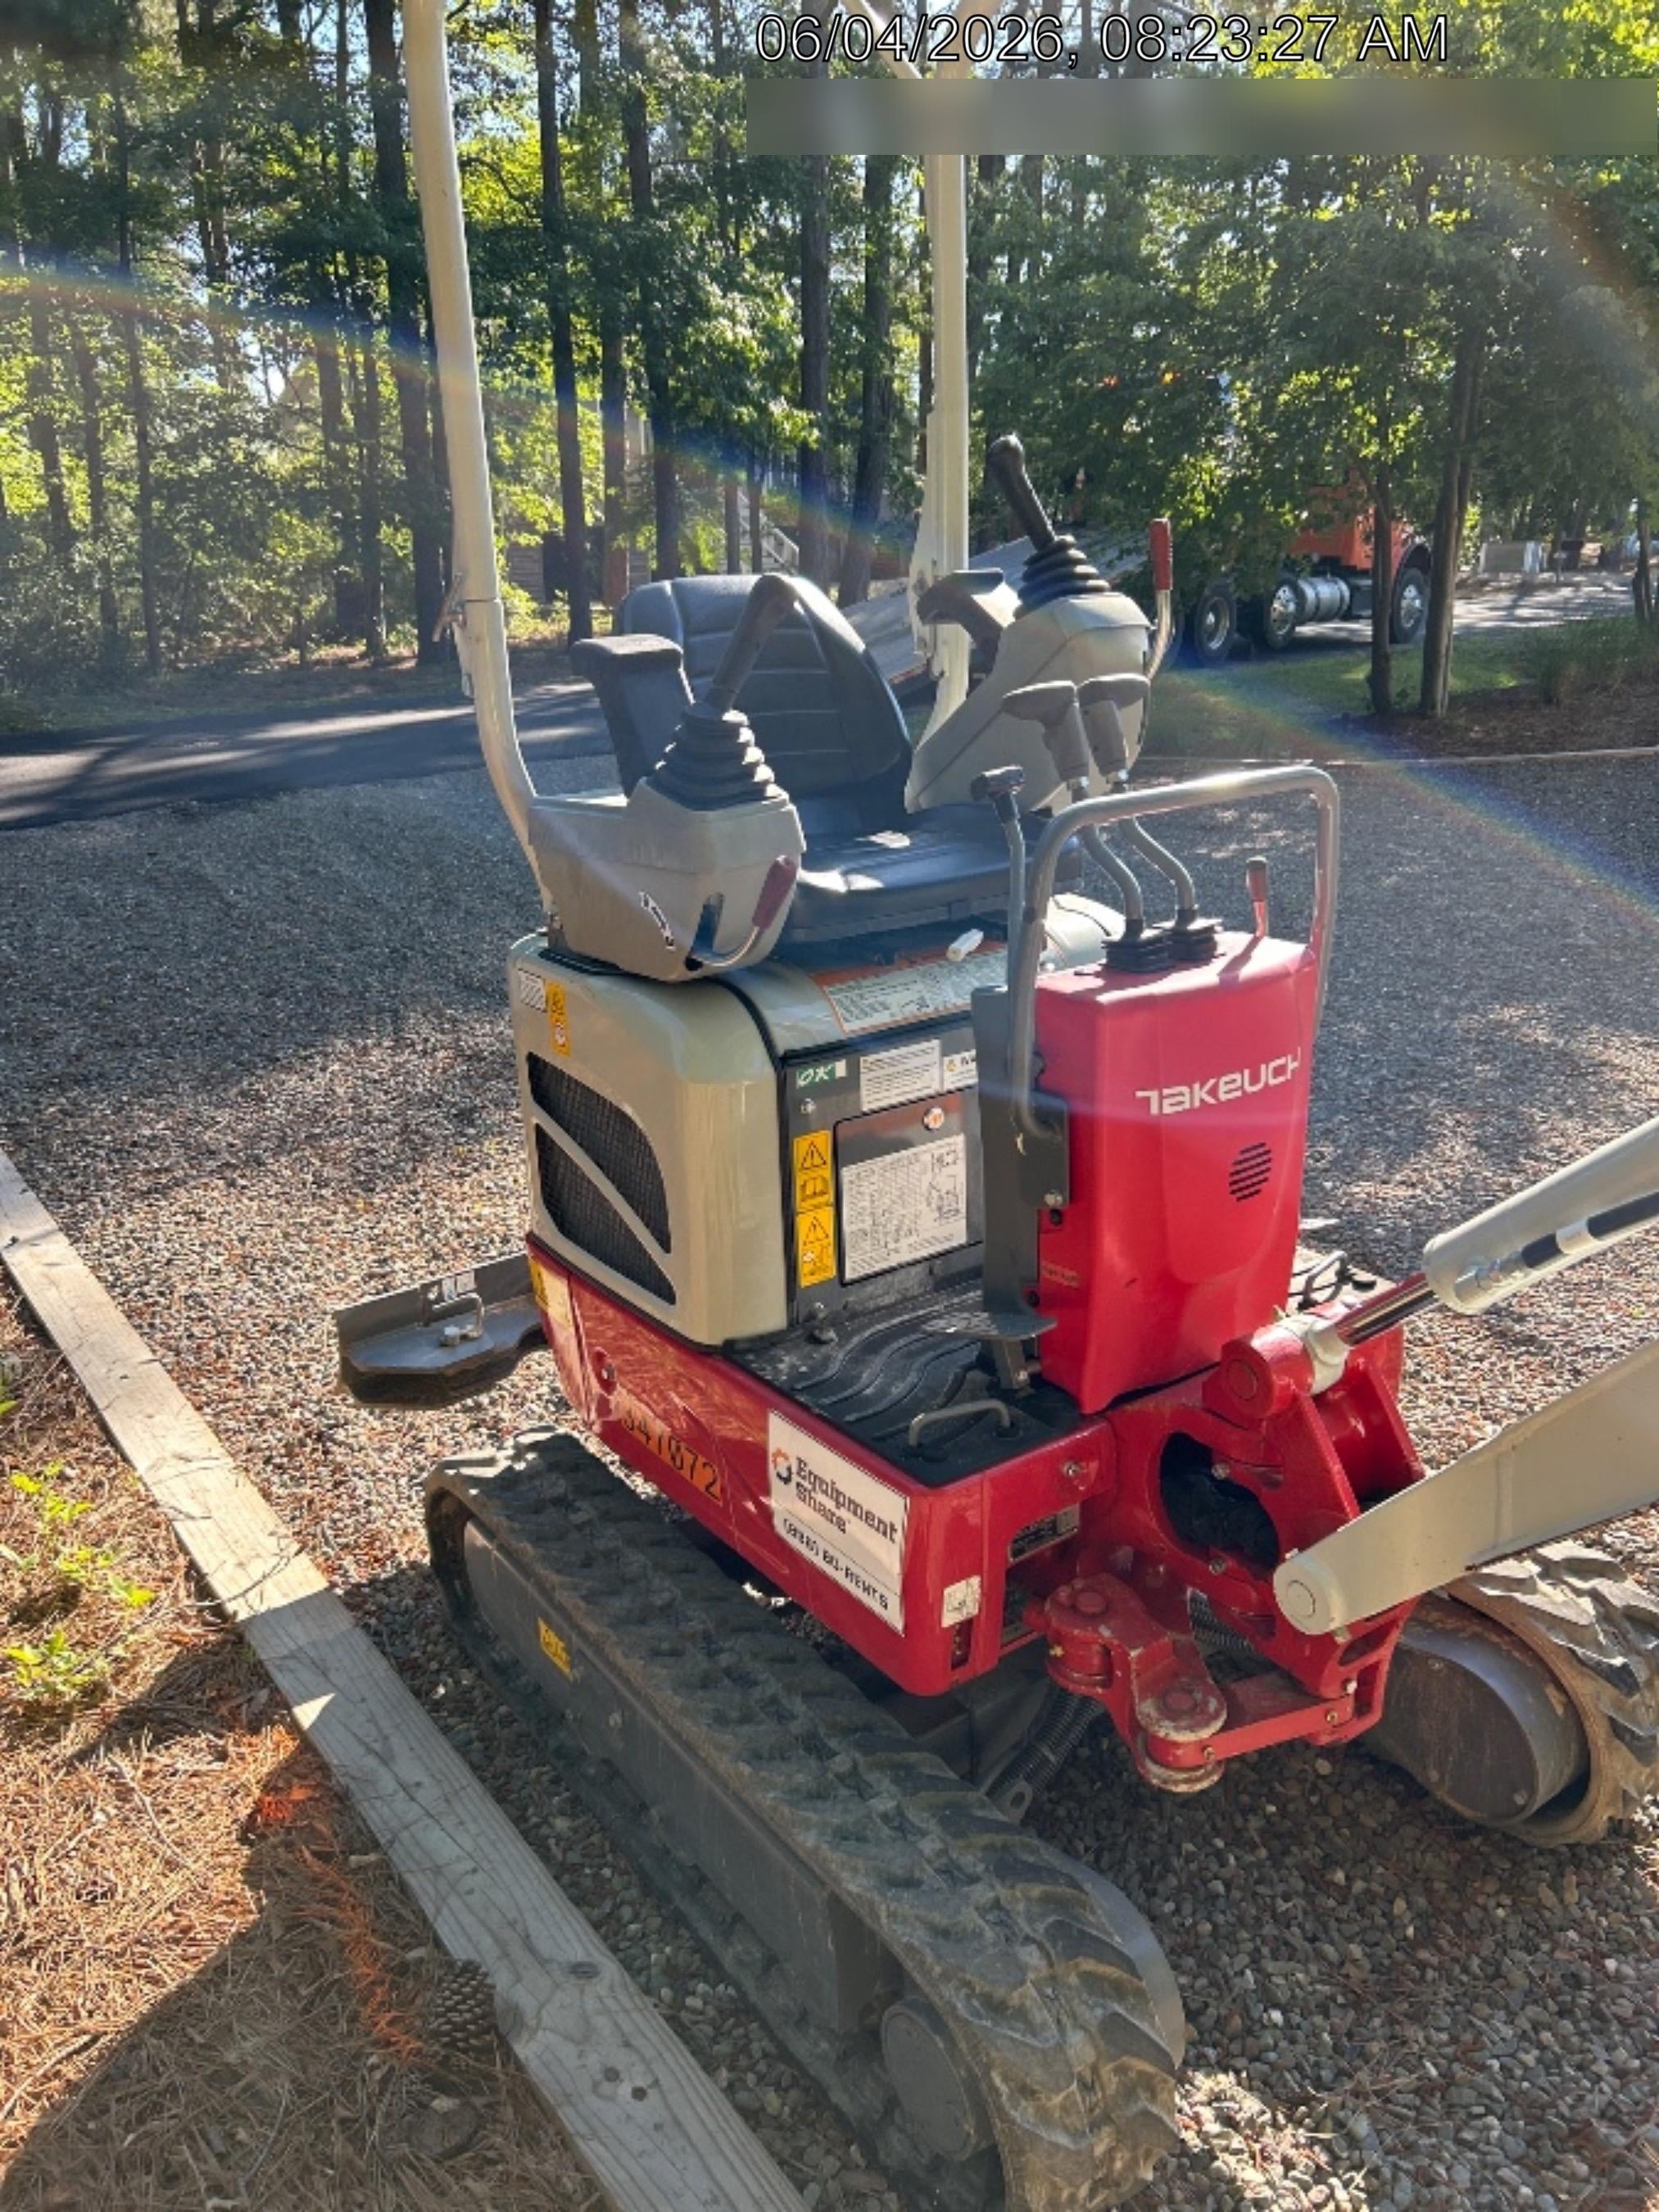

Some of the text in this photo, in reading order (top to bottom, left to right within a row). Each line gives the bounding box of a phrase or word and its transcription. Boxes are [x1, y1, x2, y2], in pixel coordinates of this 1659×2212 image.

[1134, 1046, 1301, 1116] TAKEUCH
[796, 1457, 898, 1544] Equipment
[796, 1481, 847, 1534] Share
